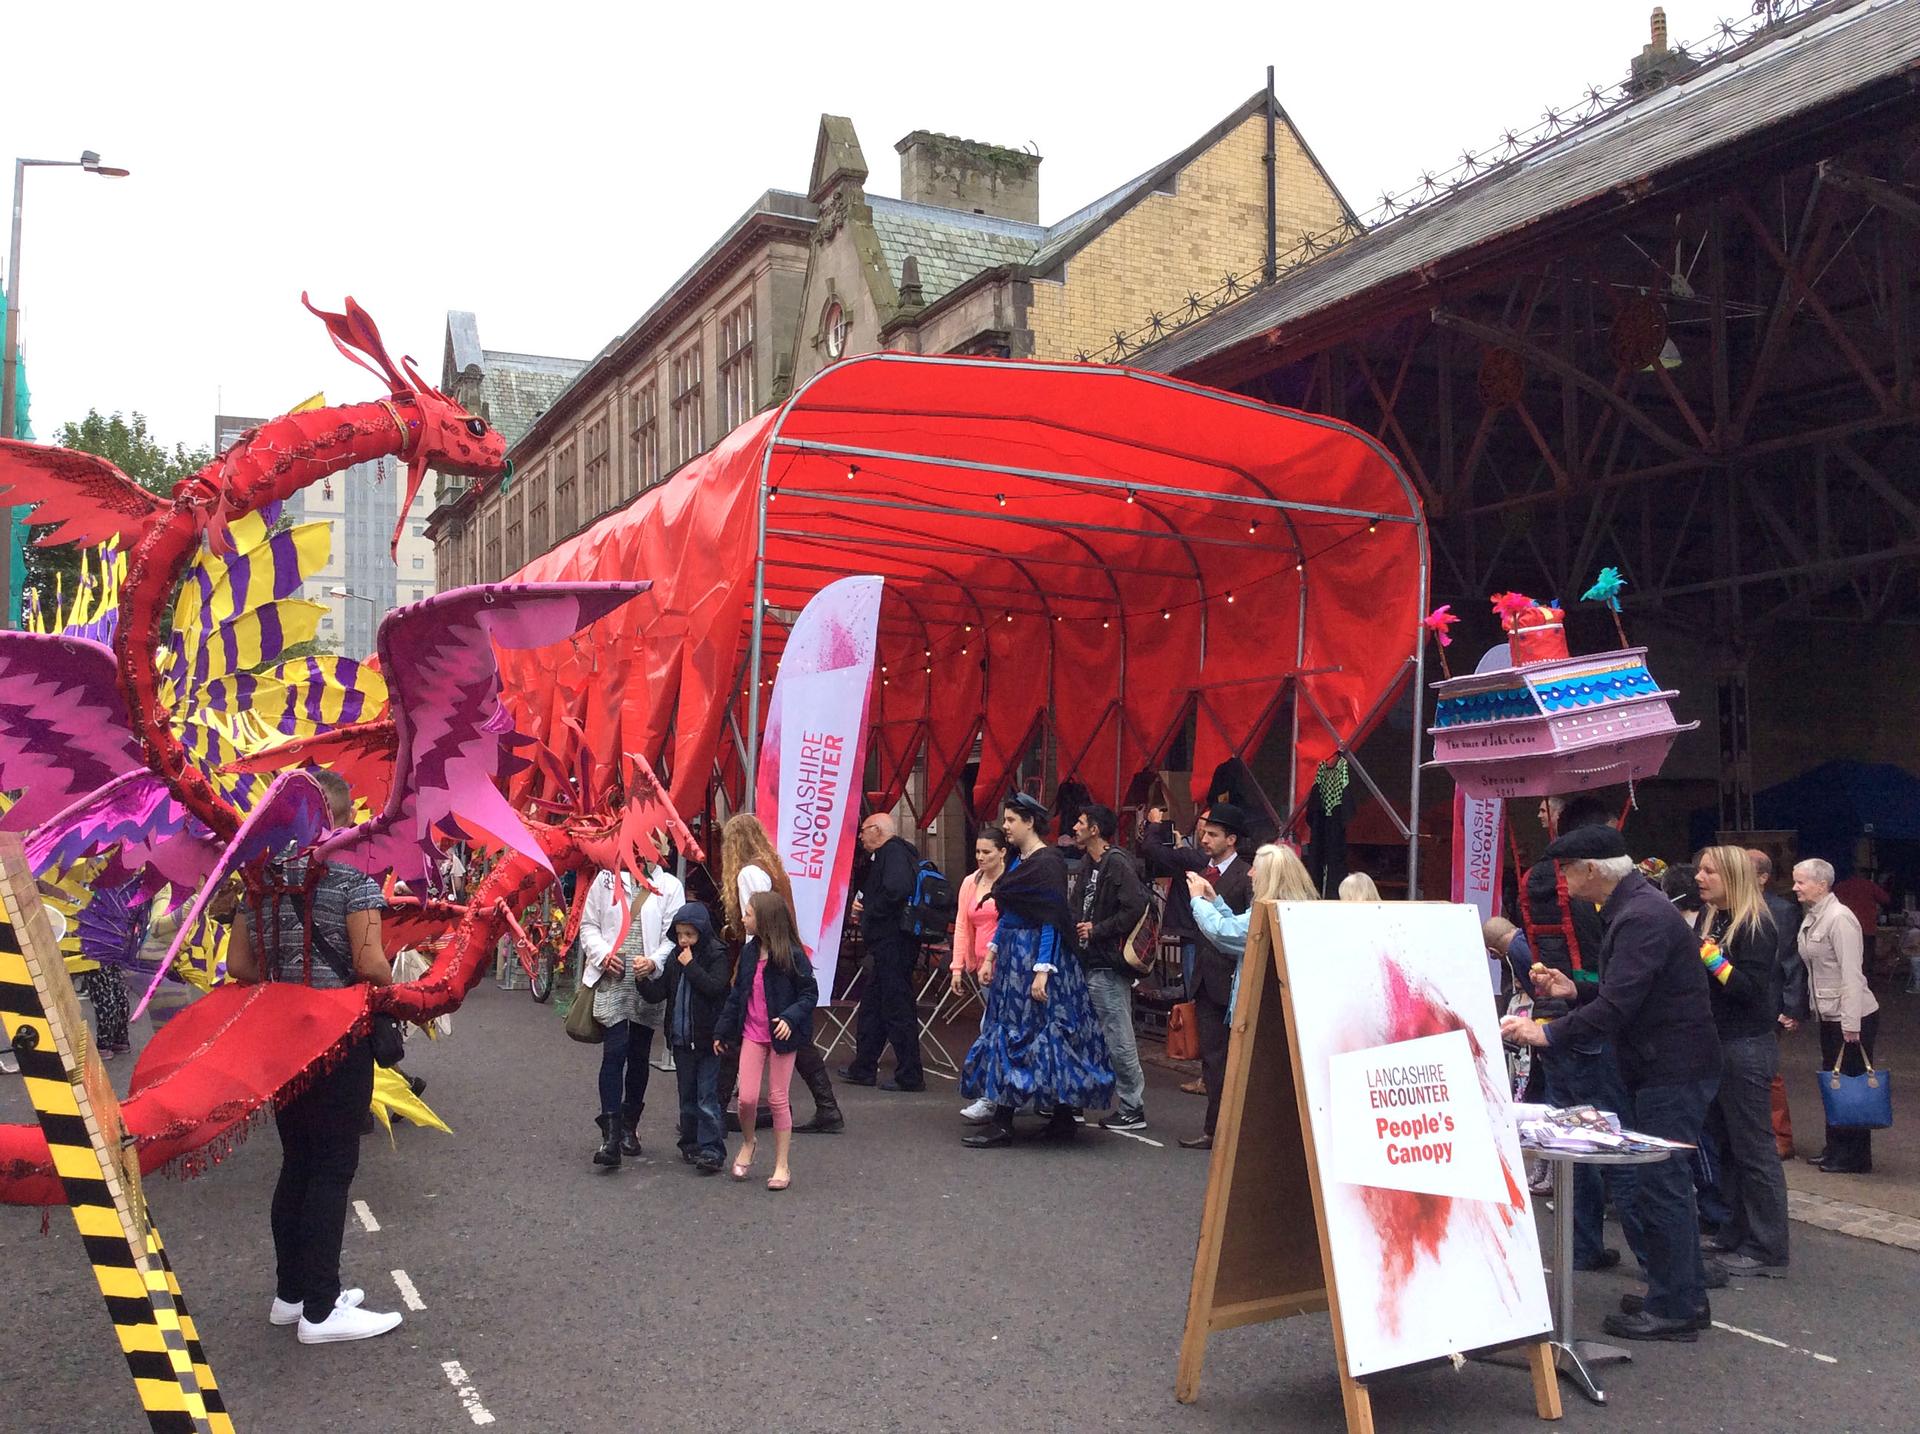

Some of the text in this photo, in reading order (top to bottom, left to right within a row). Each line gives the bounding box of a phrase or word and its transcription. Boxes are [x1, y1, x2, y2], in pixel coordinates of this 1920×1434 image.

[788, 730, 823, 878] LANCASHIRE
[808, 734, 844, 880] ENCOUNTER
[1469, 798, 1485, 891] LANCASH
[1479, 798, 1496, 892] ENCOUNT
[1366, 1064, 1447, 1088] LANCASHIRE
[1369, 1084, 1450, 1109] ENCOUNTER
[1376, 1112, 1455, 1140] People's
[1386, 1141, 1453, 1165] Canopy
